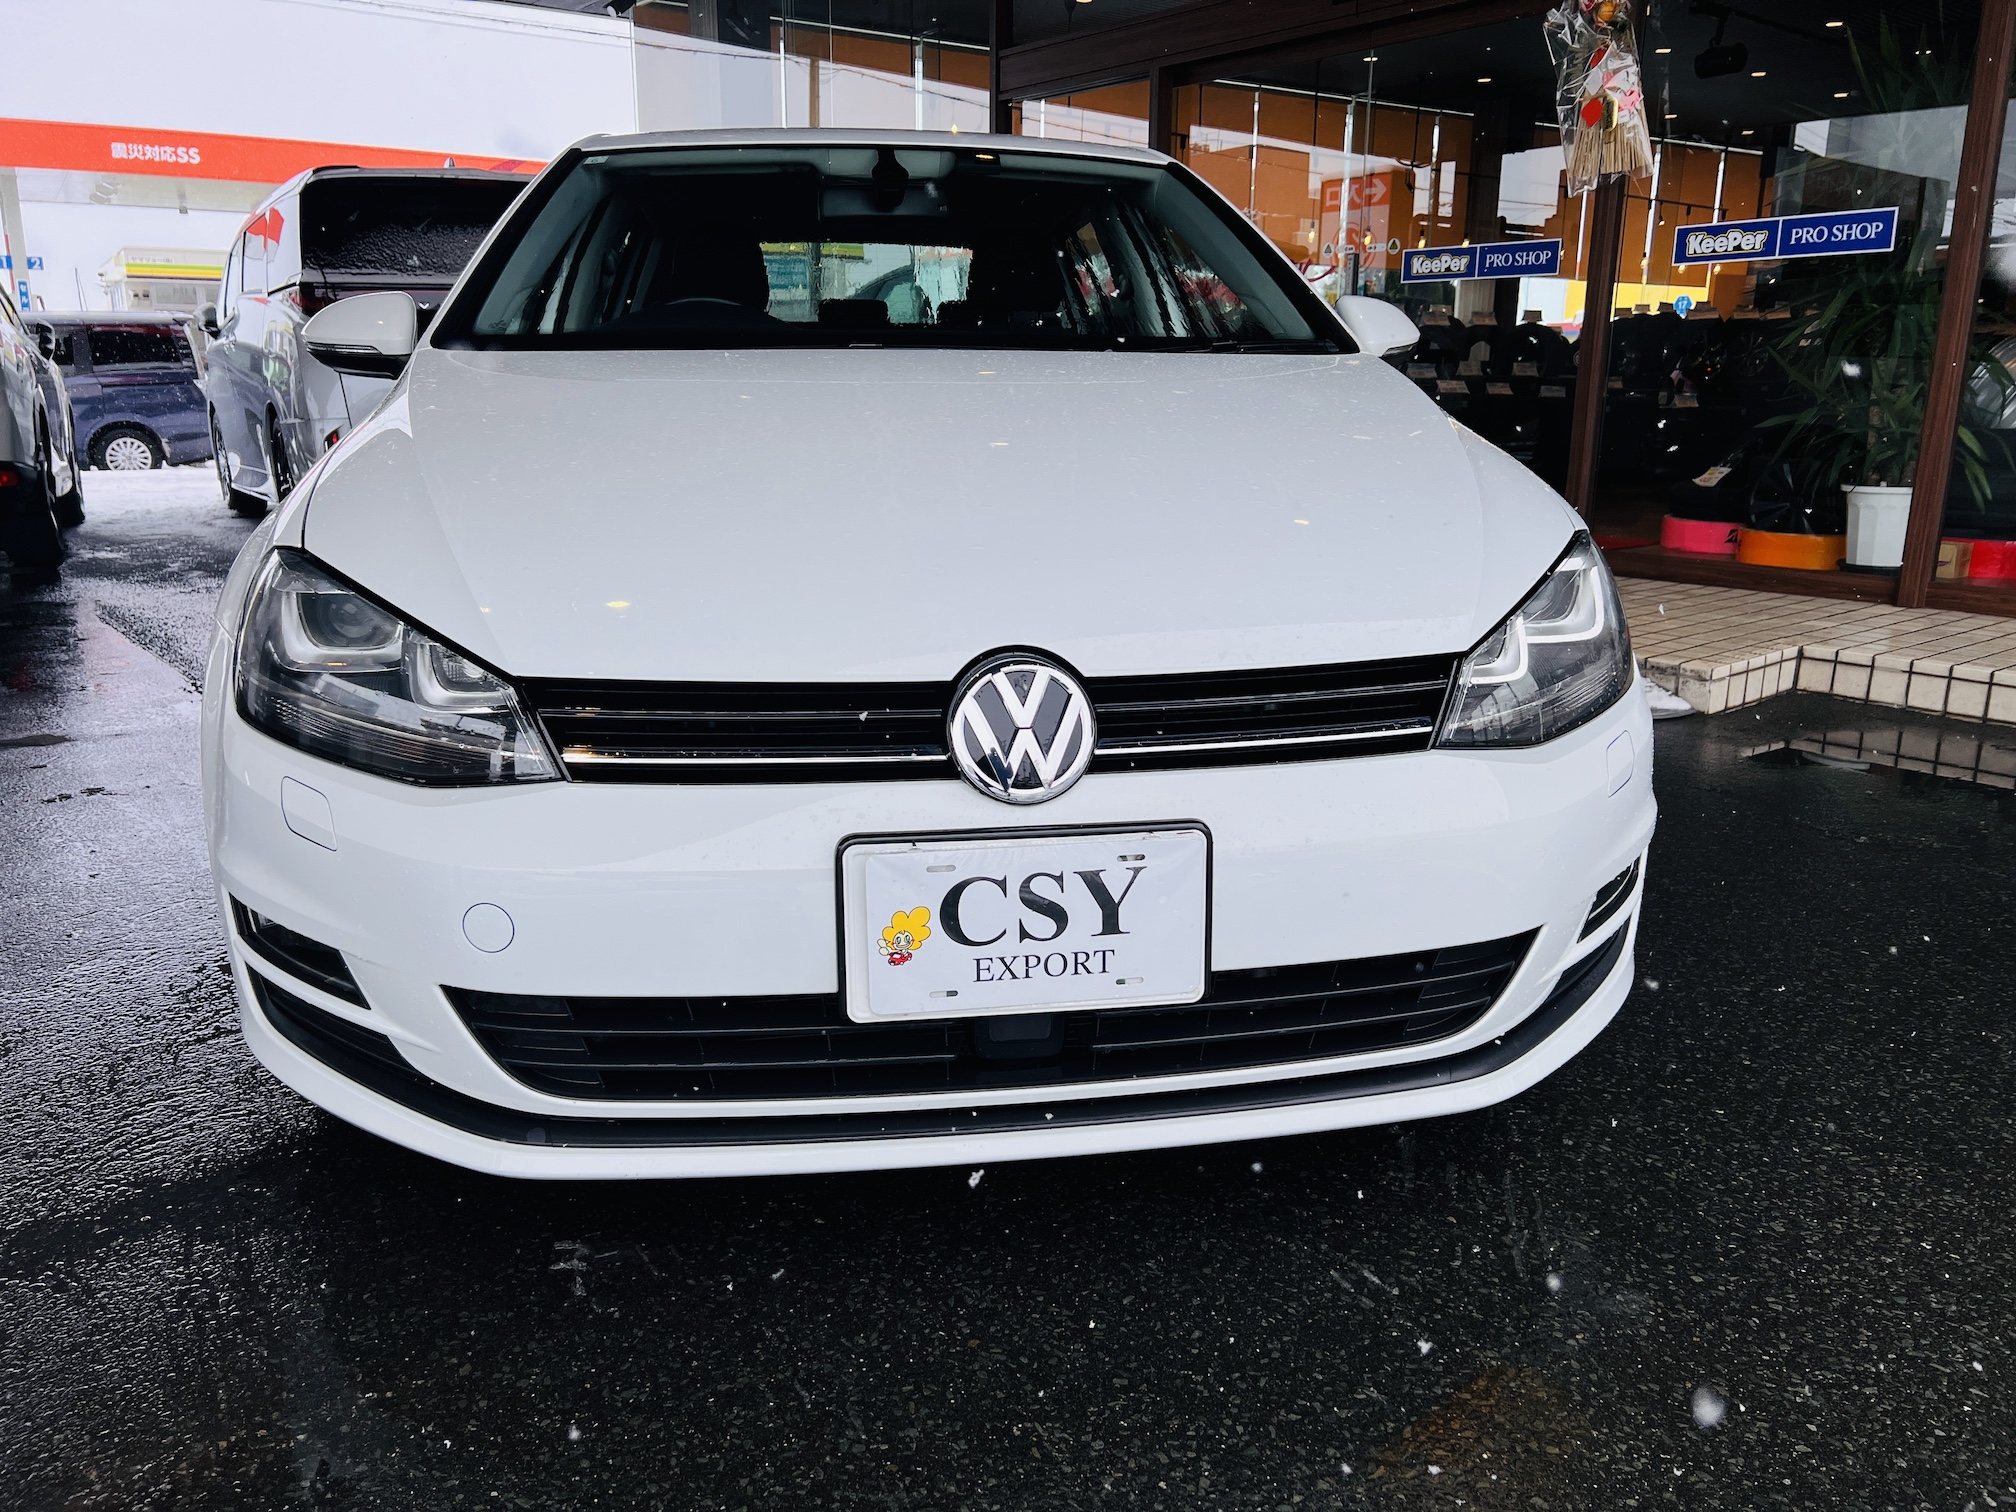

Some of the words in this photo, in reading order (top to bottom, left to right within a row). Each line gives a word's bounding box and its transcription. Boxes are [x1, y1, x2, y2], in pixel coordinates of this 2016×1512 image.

[1687, 229, 1767, 257] KeePer
[1790, 226, 1828, 245] PRO
[1831, 222, 1884, 242] SHOP
[30, 257, 42, 269] 2
[1411, 254, 1470, 275] KeePer
[1485, 253, 1512, 268] PRO
[1514, 250, 1551, 266] SHOP
[939, 866, 1147, 947] CSY
[972, 949, 1115, 983] EXPORT
